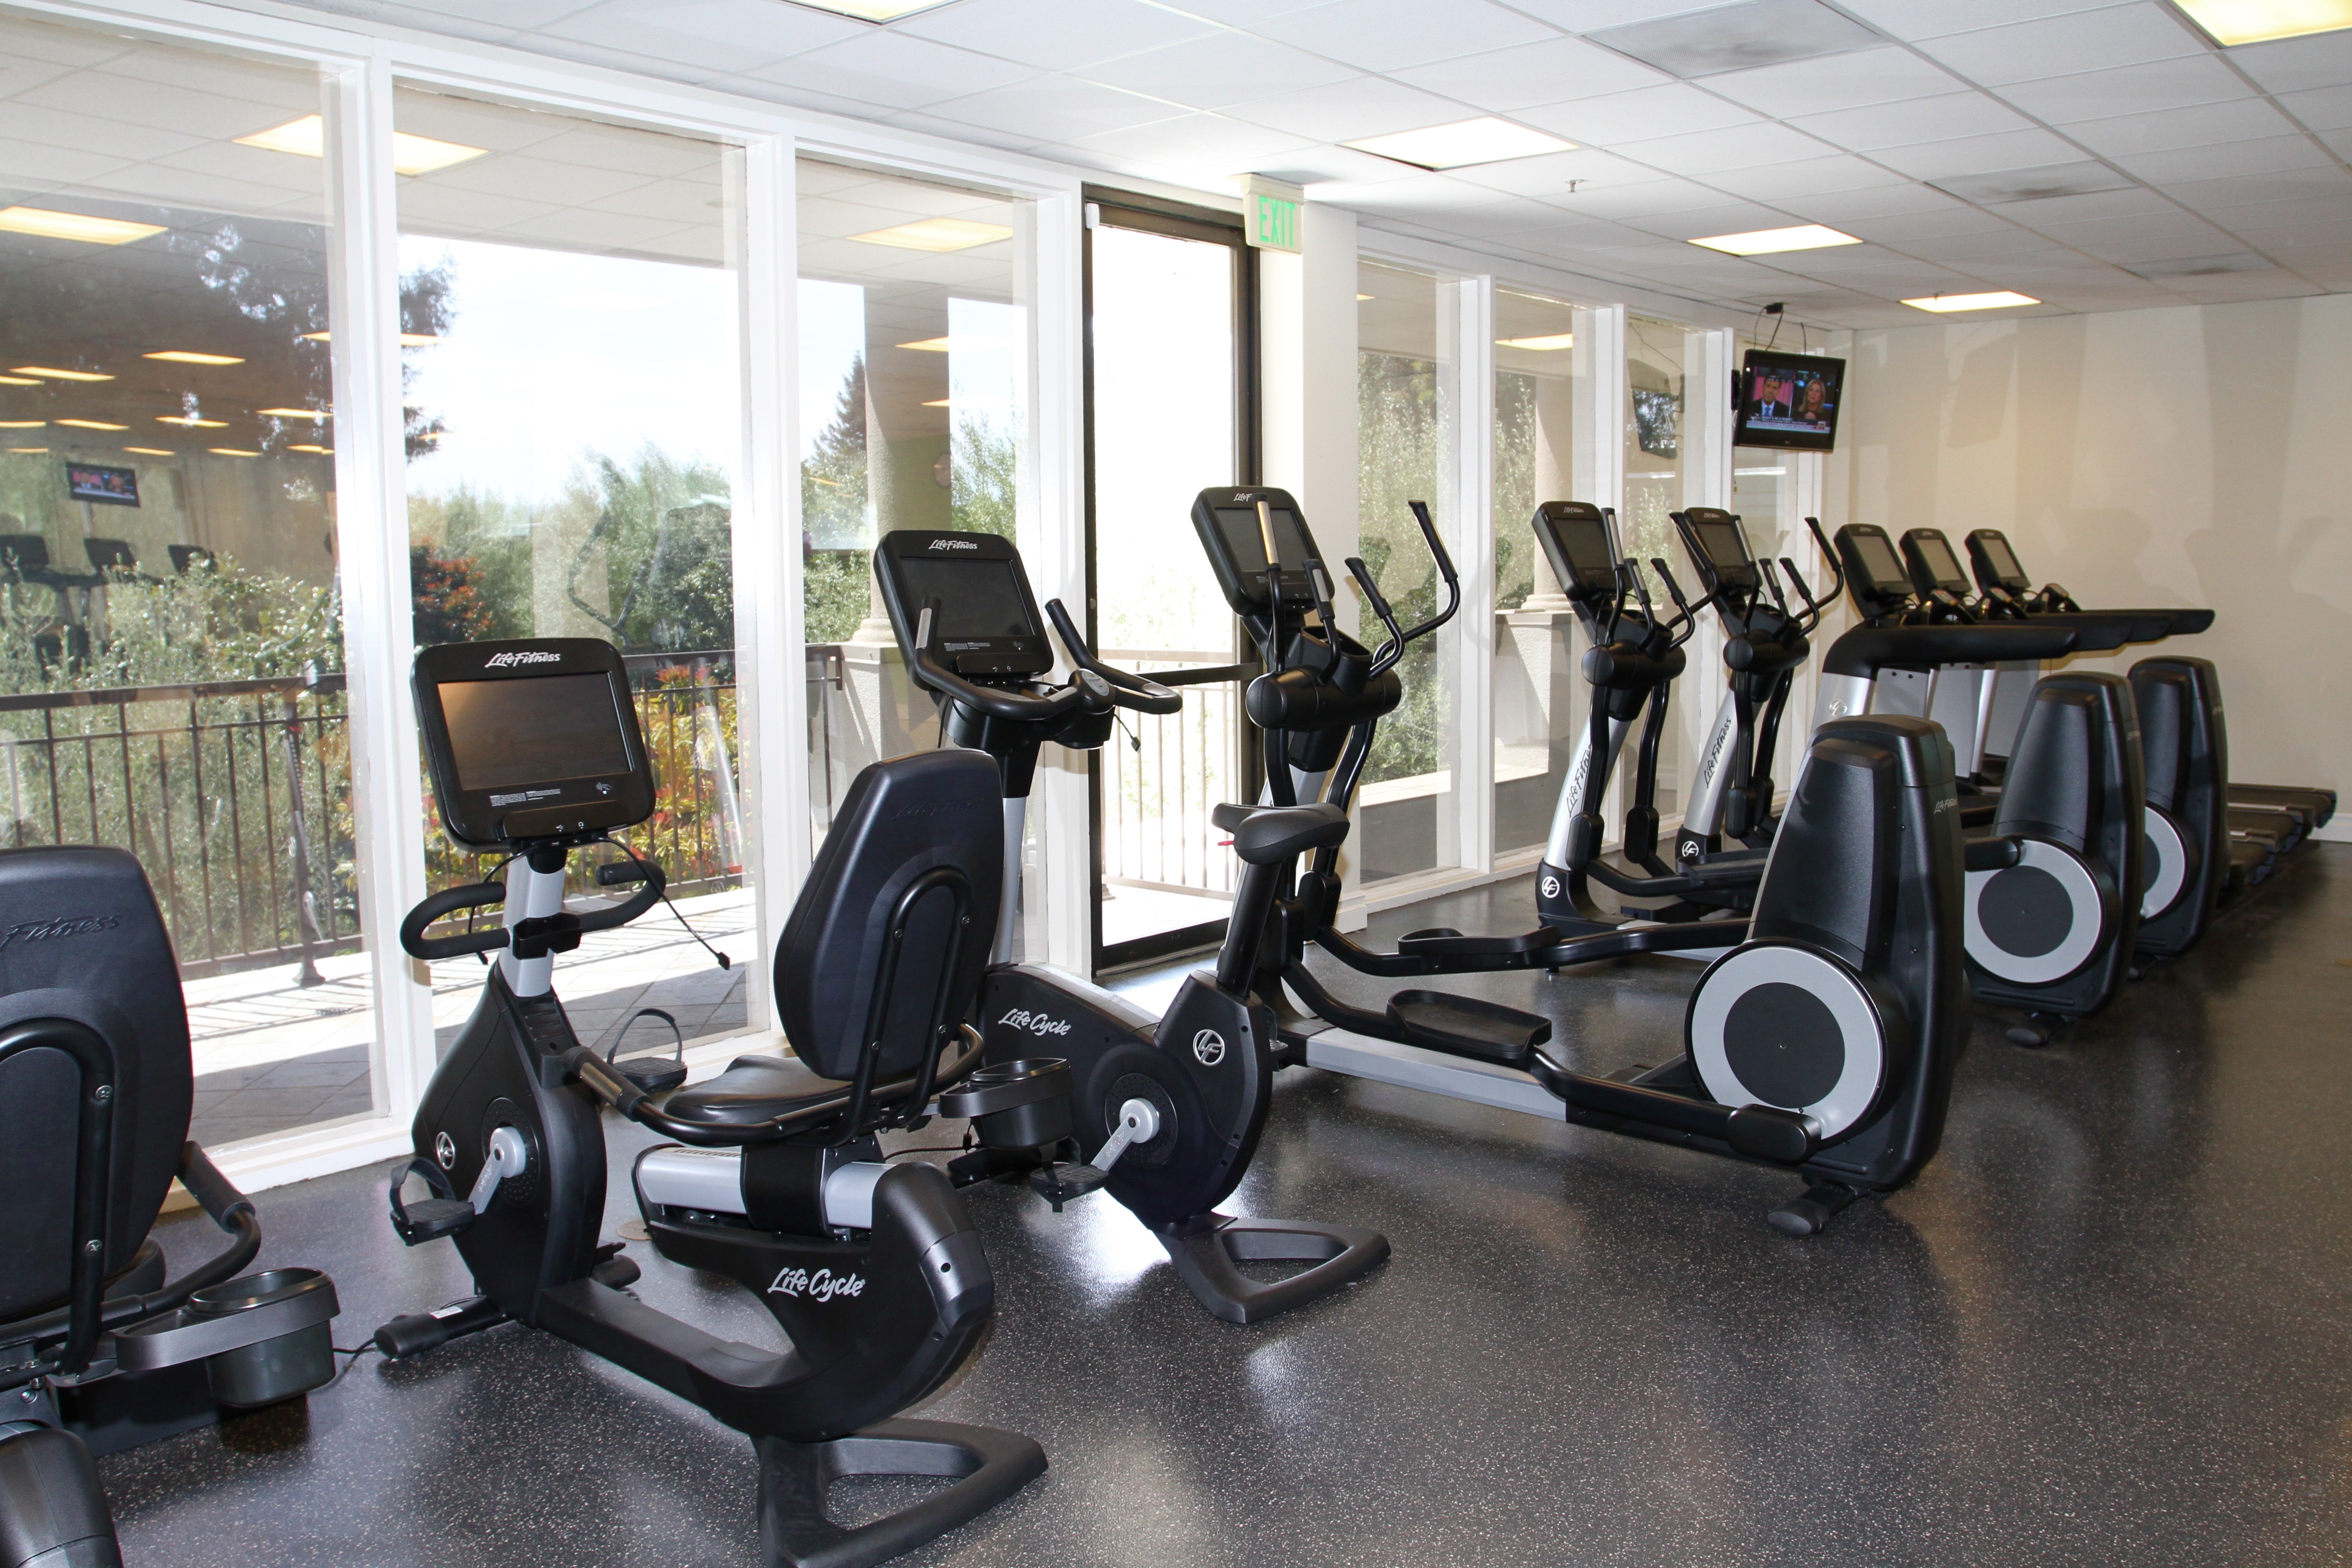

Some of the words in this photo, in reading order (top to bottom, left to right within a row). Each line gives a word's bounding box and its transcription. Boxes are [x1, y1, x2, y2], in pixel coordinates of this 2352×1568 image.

[1259, 196, 1295, 247] EXIT
[998, 1008, 1031, 1030] Life
[767, 1267, 808, 1297] Life
